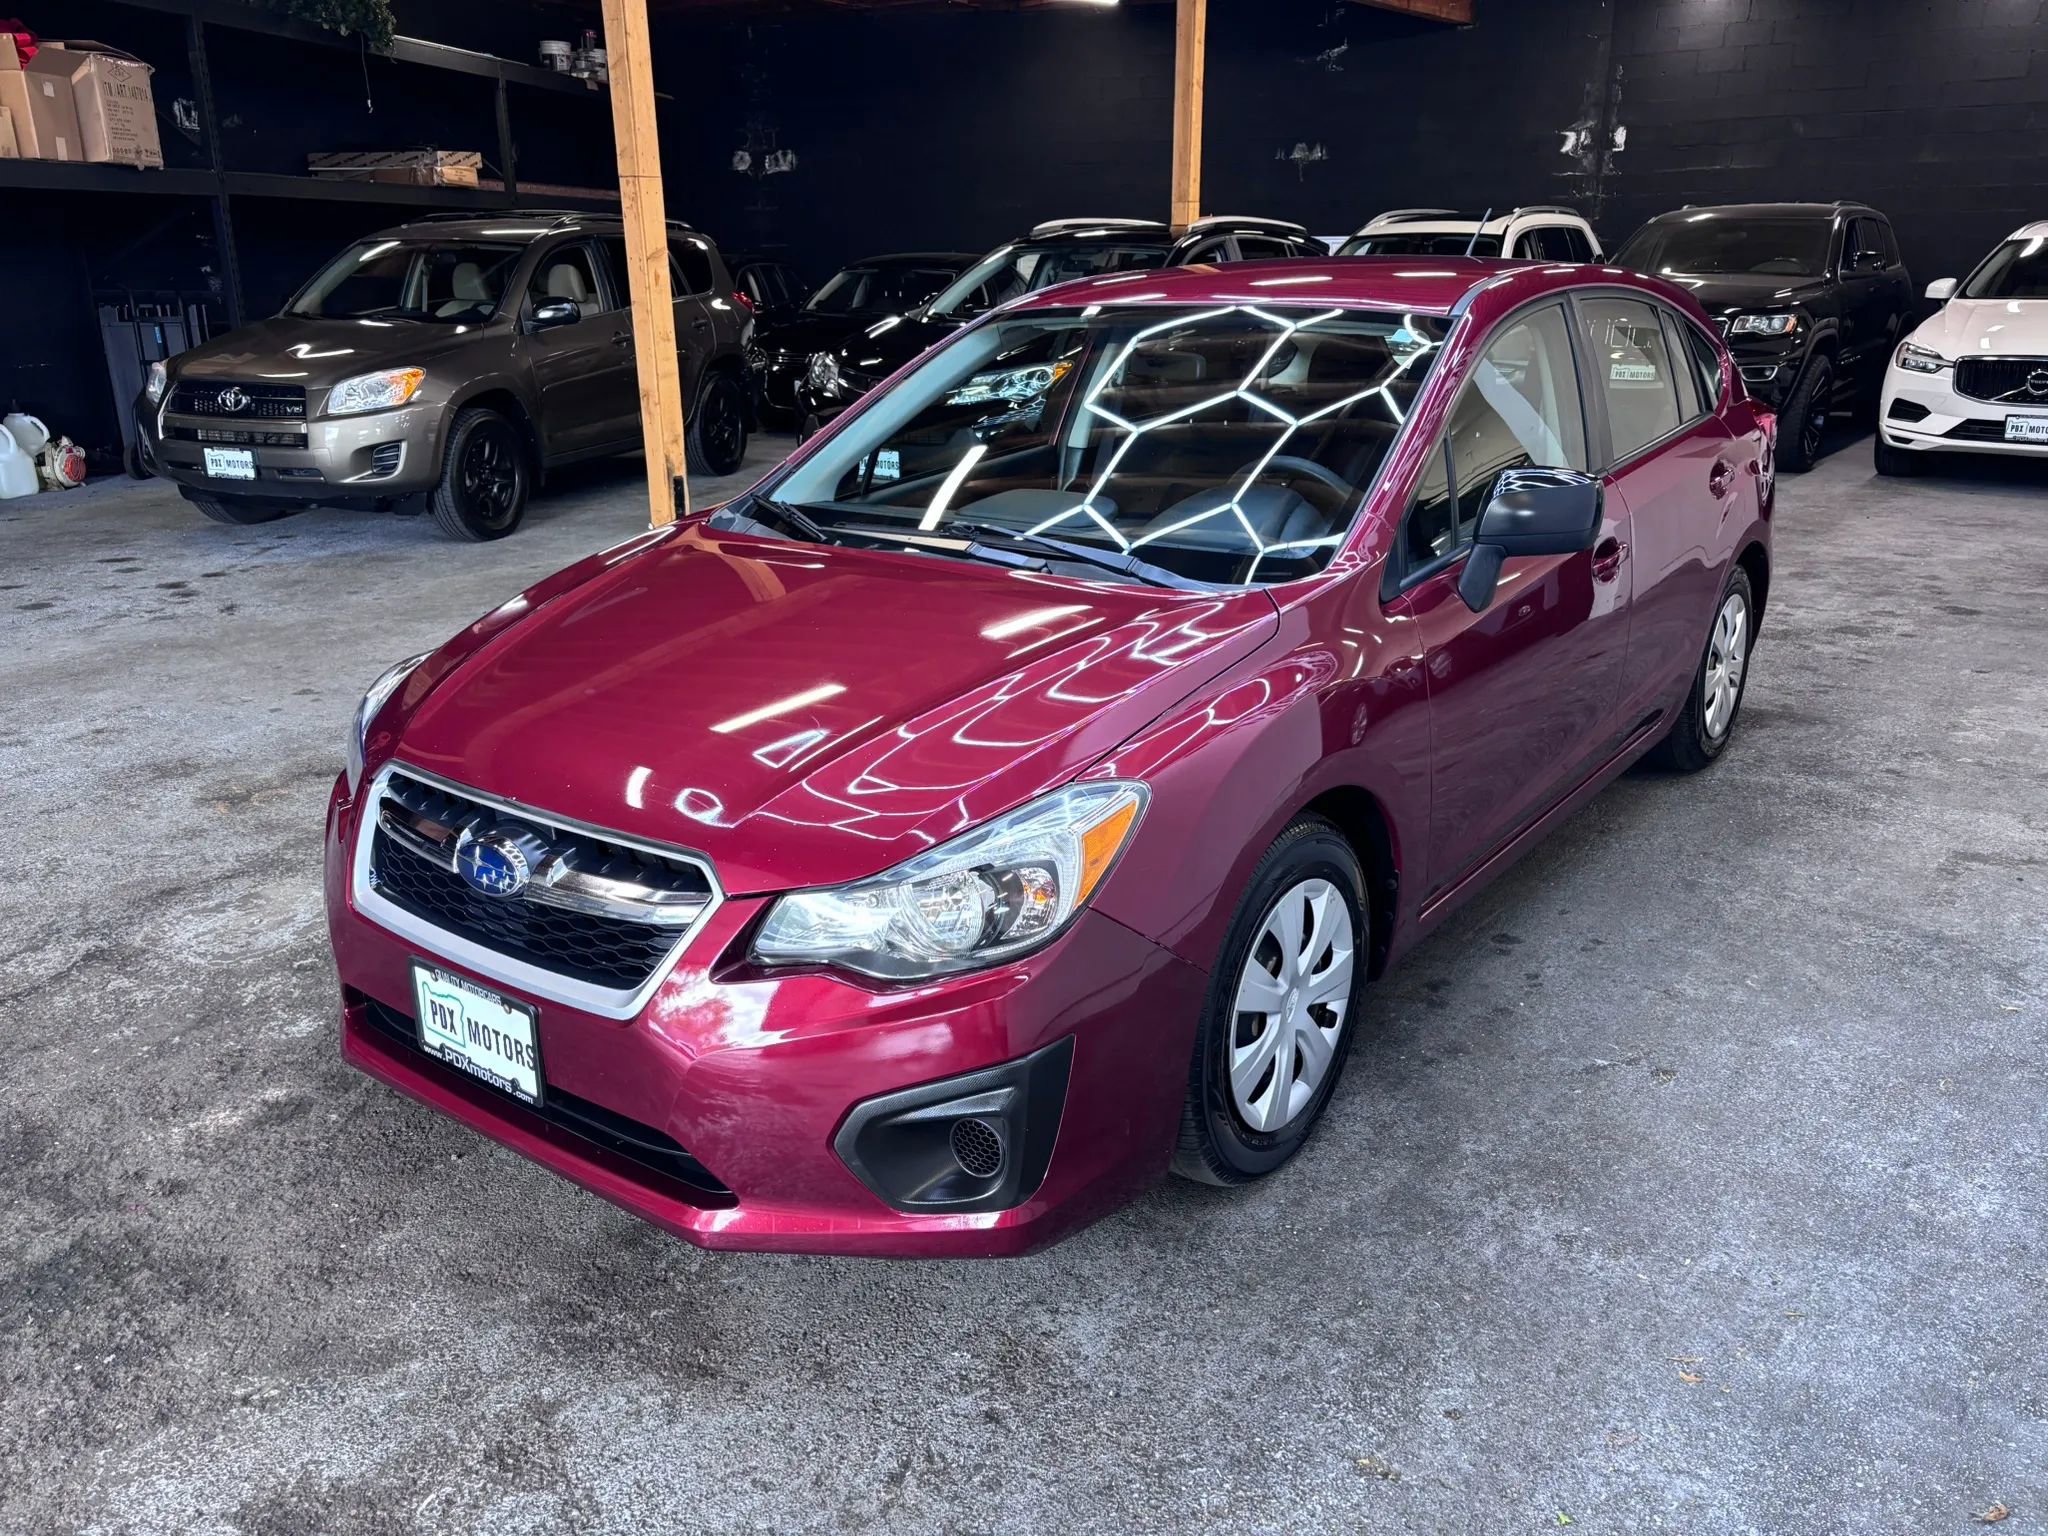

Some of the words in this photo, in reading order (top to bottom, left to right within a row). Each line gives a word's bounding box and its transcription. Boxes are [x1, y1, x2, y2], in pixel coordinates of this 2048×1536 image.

[2010, 424, 2024, 433] PDX
[225, 459, 254, 469] MOTORS
[434, 968, 460, 987] QUALITY
[460, 979, 502, 1005] MOTORCARS
[430, 999, 458, 1036] PDX
[466, 1017, 536, 1071] MOTORS
[424, 1045, 534, 1104] www.PDXmotors.com
